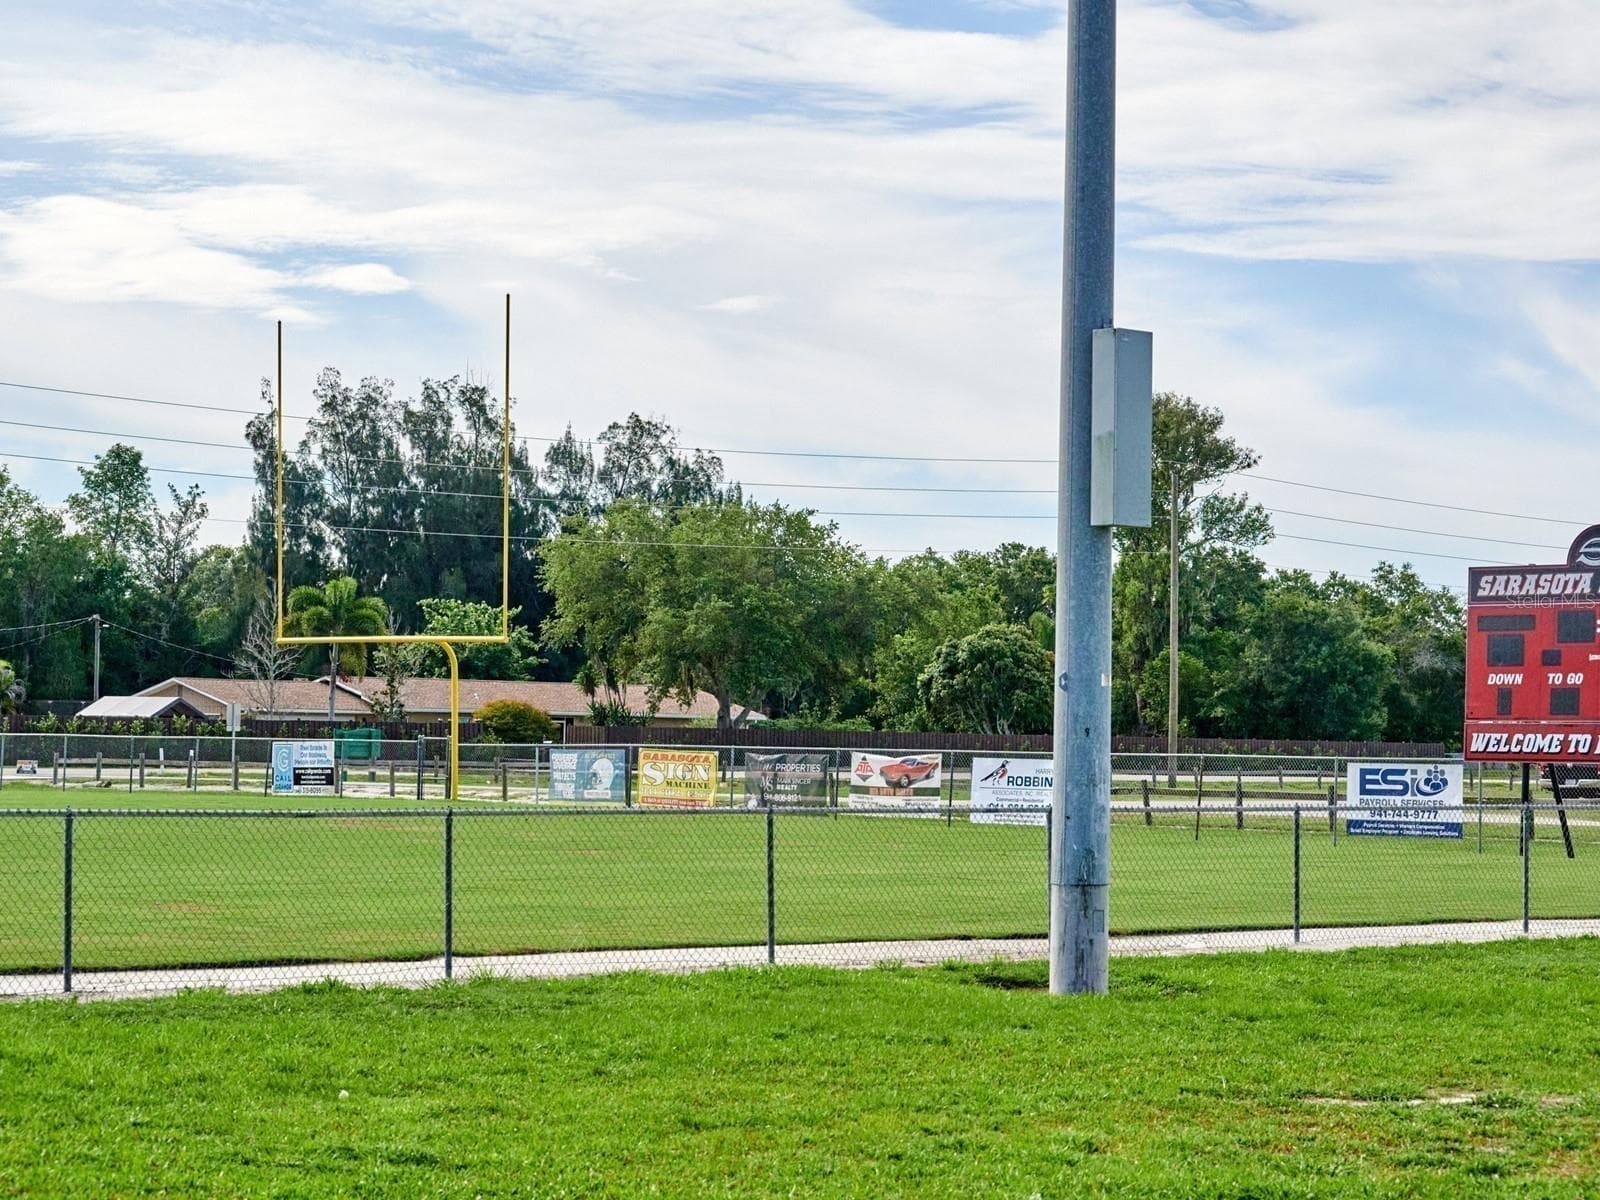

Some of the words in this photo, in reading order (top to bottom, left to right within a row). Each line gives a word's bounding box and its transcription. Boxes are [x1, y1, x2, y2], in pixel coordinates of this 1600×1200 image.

[1477, 573, 1594, 596] SARASOTA
[1487, 673, 1523, 685] DOWN
[1547, 673, 1562, 685] TO
[1567, 673, 1584, 685] GO
[1470, 733, 1564, 753] WELCOME
[1567, 734, 1592, 753] TO
[643, 752, 711, 763] SARASOTA
[775, 763, 821, 772] PROPERTIES
[643, 762, 711, 786] SIGN
[666, 781, 710, 789] MACHINE
[1360, 799, 1398, 807] PAYROLL
[1369, 810, 1439, 819] 941-744-9777
